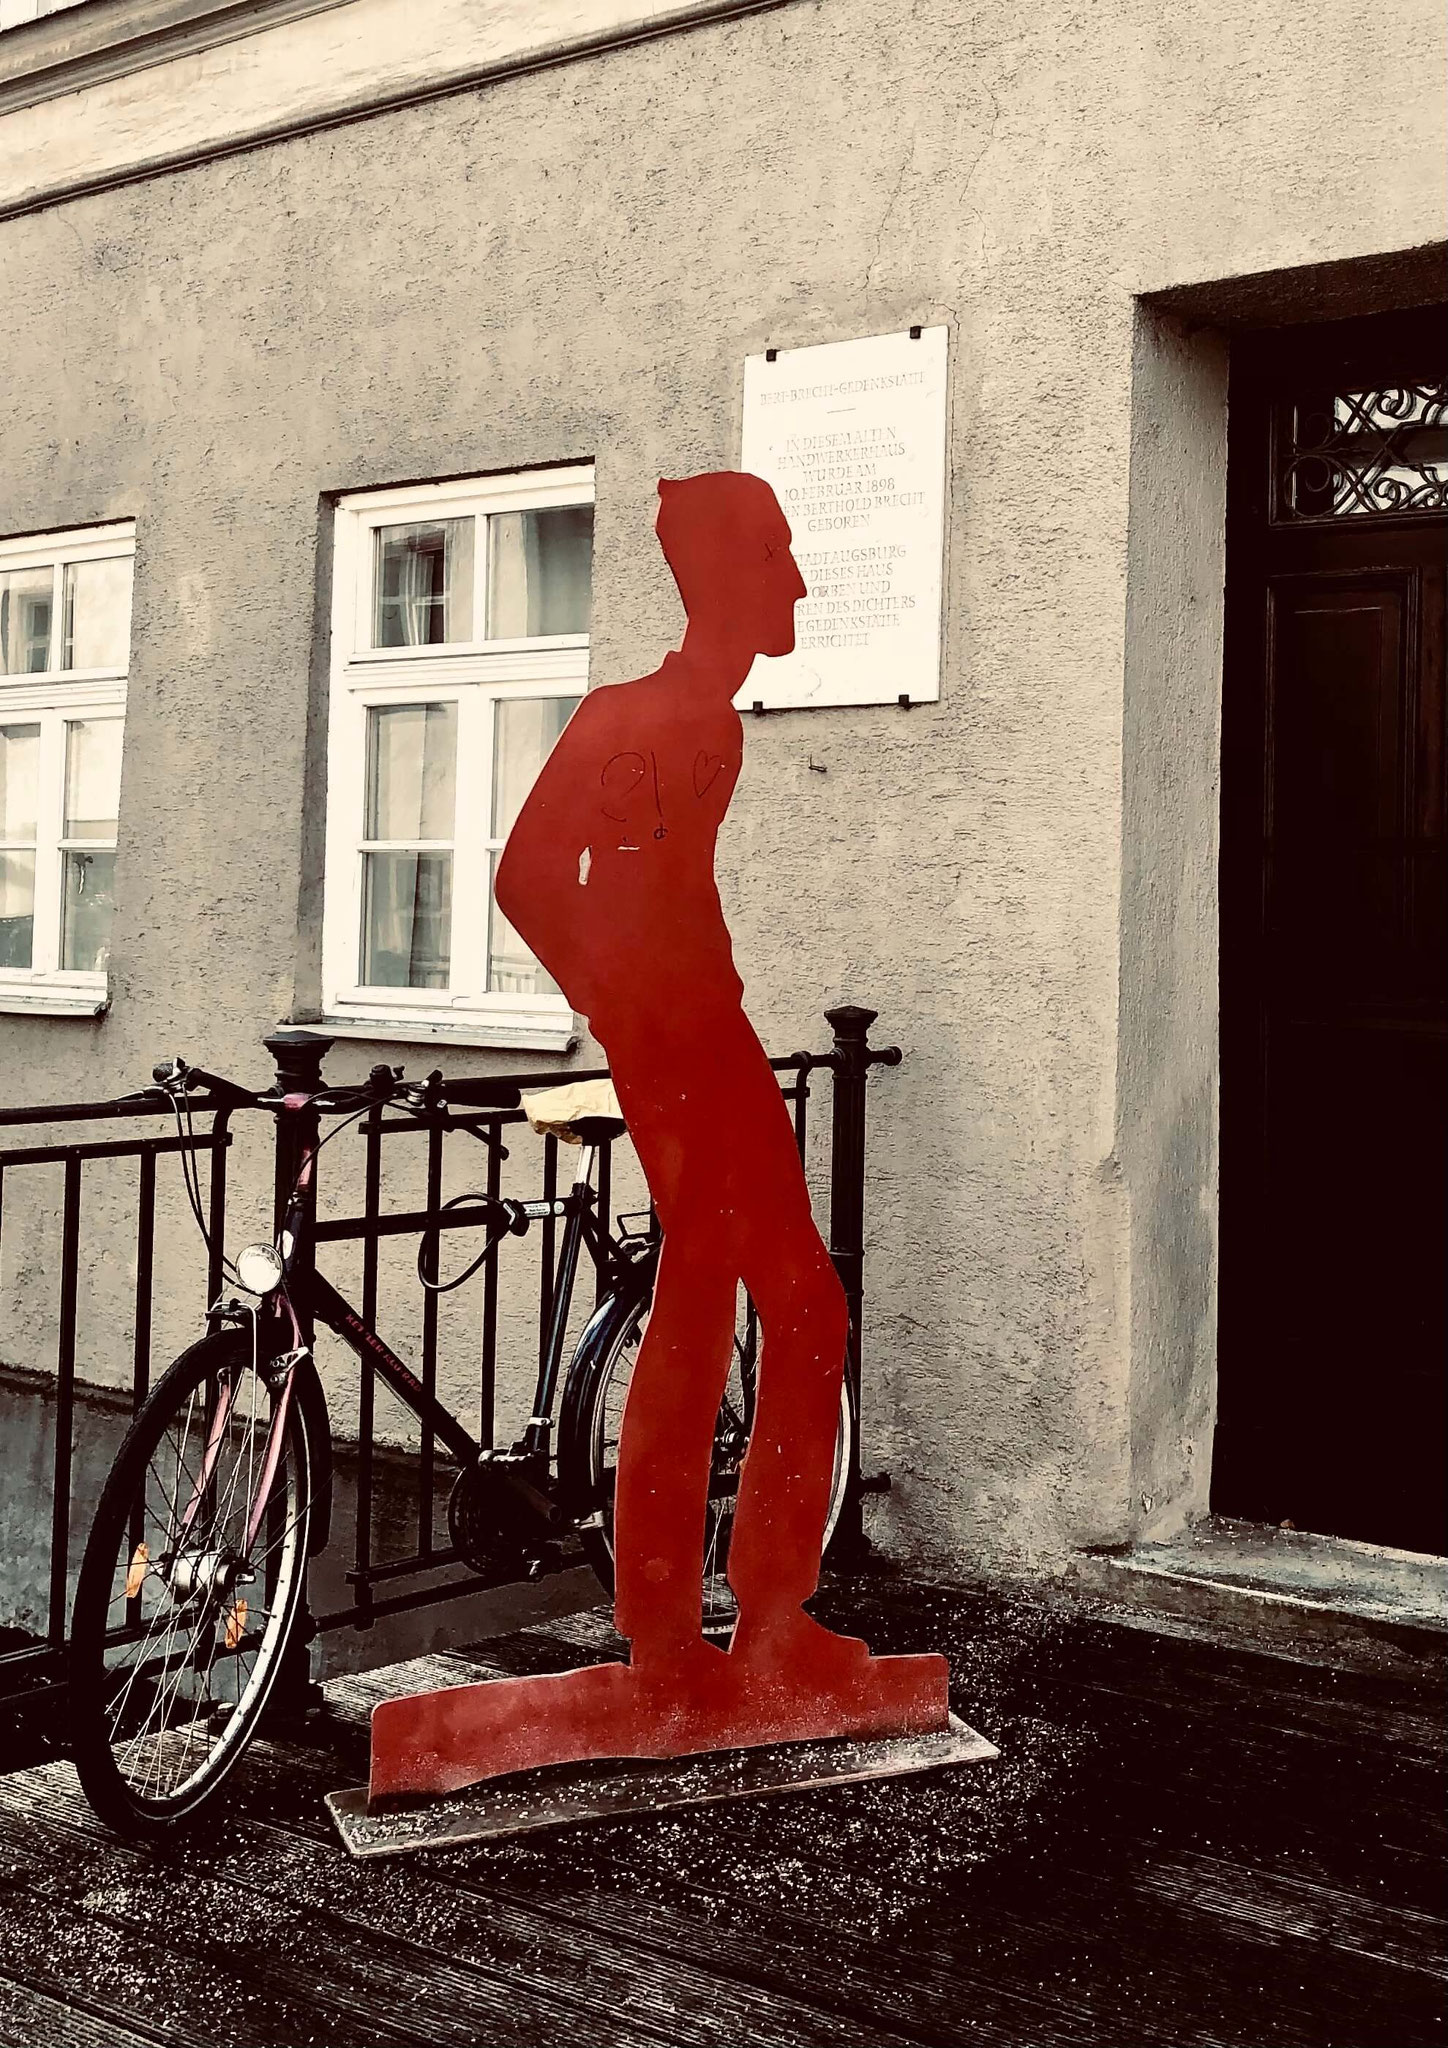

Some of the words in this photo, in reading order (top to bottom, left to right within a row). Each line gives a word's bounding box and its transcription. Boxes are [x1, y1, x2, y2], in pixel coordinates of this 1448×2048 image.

[786, 438, 800, 452] IN
[803, 432, 852, 449] DIESEM
[855, 426, 897, 443] ALTEN
[777, 442, 906, 469] HANDWERKERHAUS
[802, 466, 854, 483] WURDE
[857, 463, 877, 477] AM
[802, 481, 863, 500] FEBRUAR
[866, 477, 896, 493] 1898
[803, 497, 872, 516] BERTHOLD
[874, 491, 926, 508] BRECHT
[808, 514, 871, 532] GEBOREN
[794, 551, 830, 566] TADT
[831, 545, 906, 564] AUGSBURG
[809, 566, 854, 582] DIESES
[857, 562, 894, 578] HAUS
[859, 580, 891, 594] UND
[827, 600, 850, 614] DES
[853, 595, 916, 612] DICHTERS
[800, 633, 870, 649] ERRICHTET
